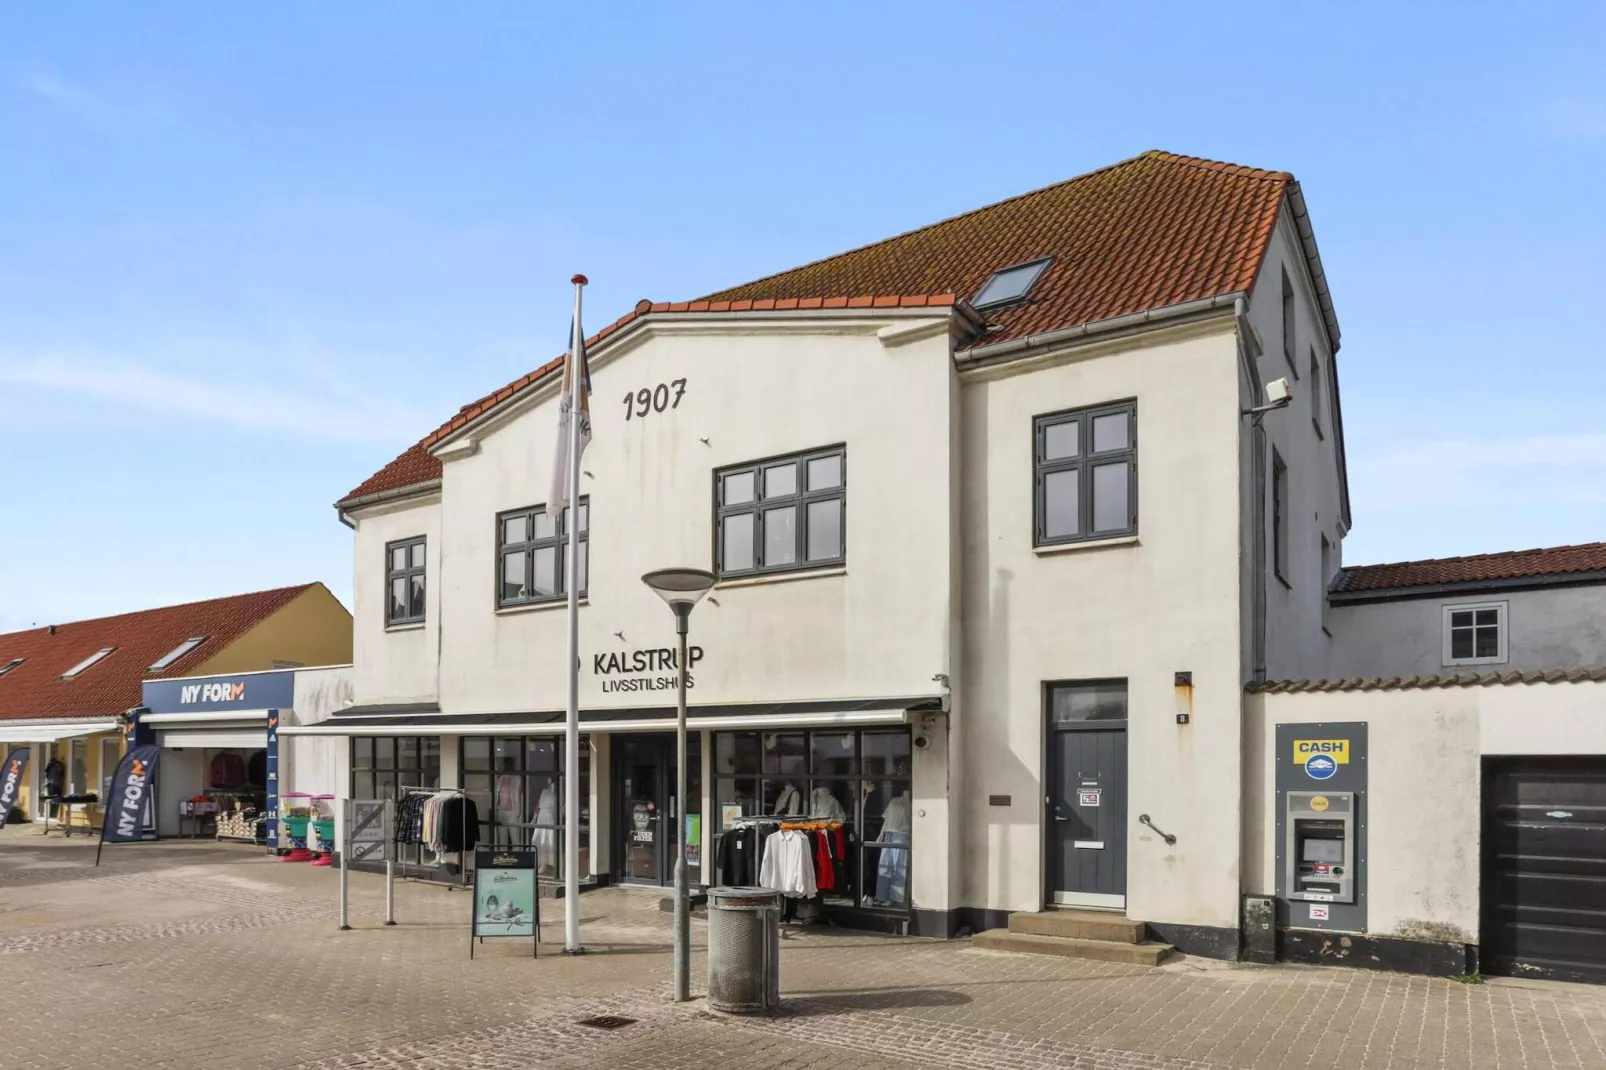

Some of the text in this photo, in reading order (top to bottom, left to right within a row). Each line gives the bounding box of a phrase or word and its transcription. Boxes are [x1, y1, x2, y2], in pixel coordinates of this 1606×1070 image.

[623, 377, 687, 421] 1907
[181, 682, 244, 704] NY FORM
[1180, 714, 1185, 723] 8
[1299, 742, 1343, 753] CASH
[1, 760, 22, 803] FORM
[116, 759, 148, 837] NY FORM
